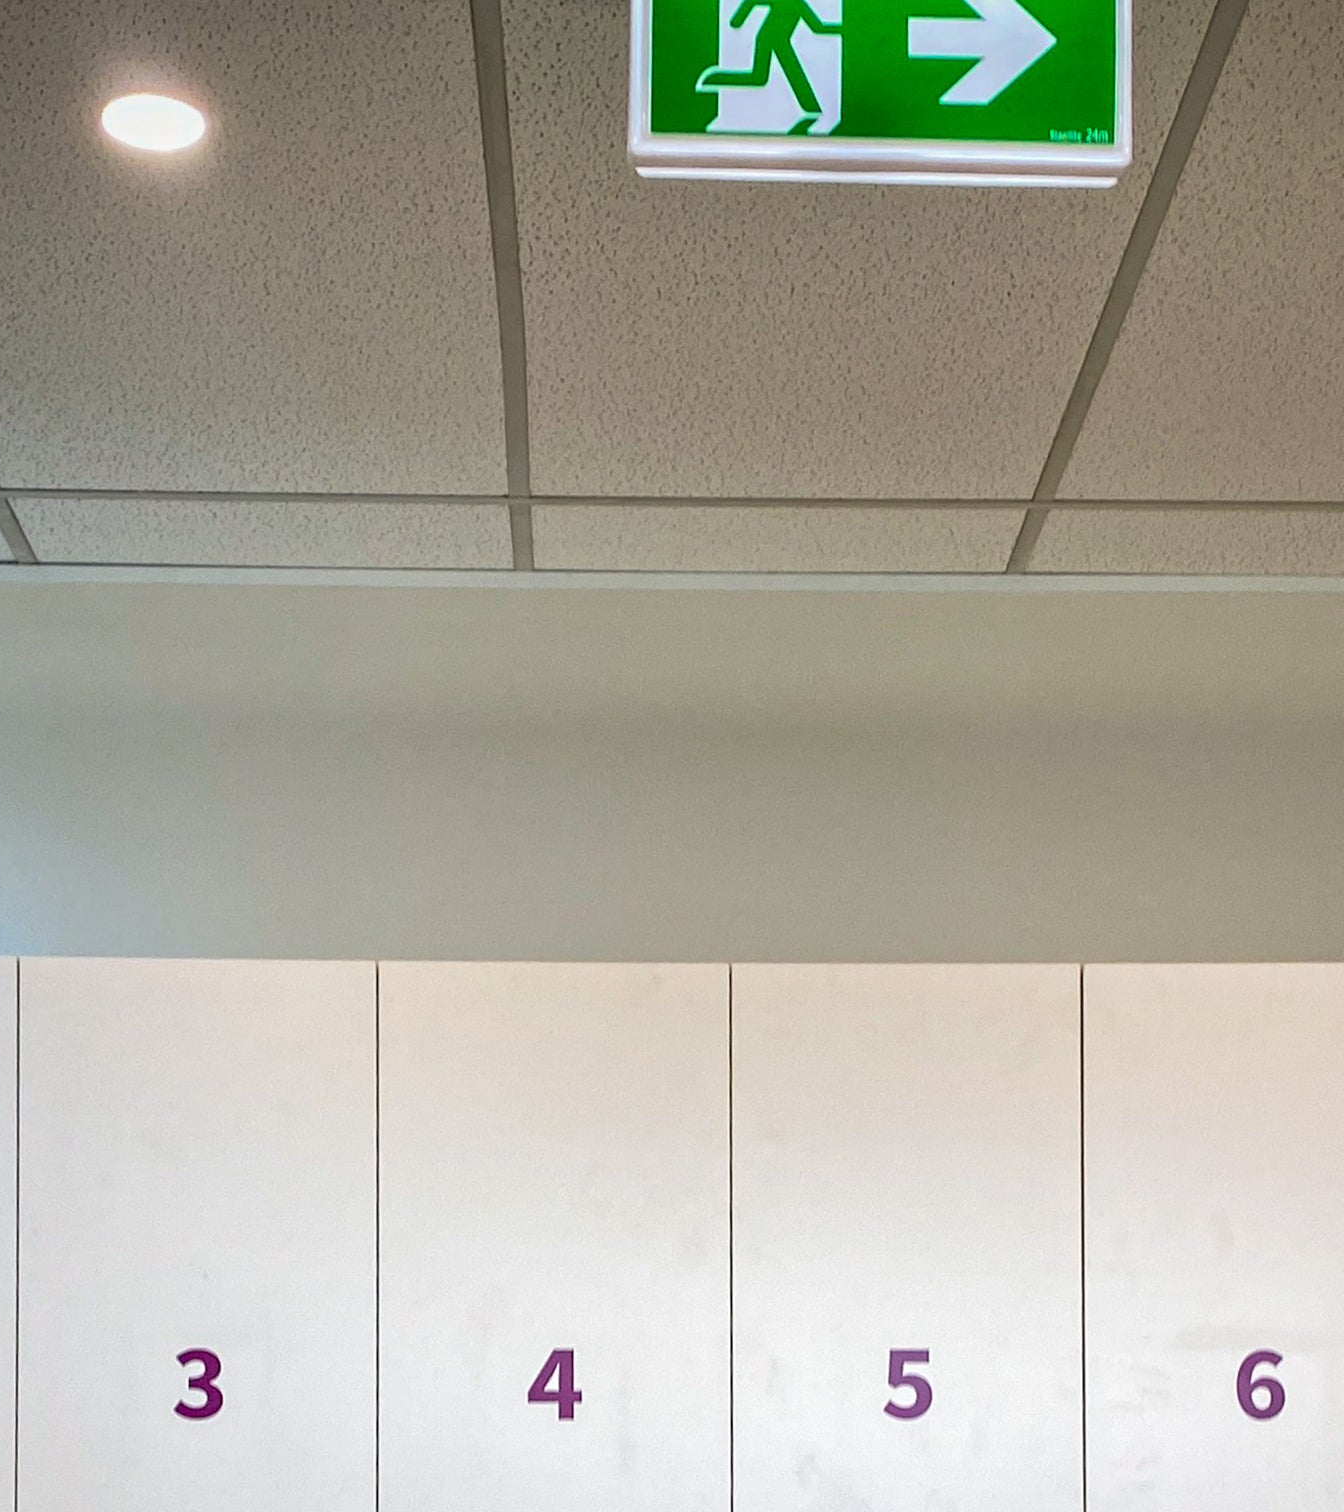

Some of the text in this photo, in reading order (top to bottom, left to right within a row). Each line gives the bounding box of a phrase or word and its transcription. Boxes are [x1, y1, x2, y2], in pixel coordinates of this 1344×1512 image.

[175, 1350, 223, 1419] 3
[528, 1350, 582, 1419] 4
[885, 1351, 932, 1418] 5
[1237, 1352, 1285, 1419] 6
